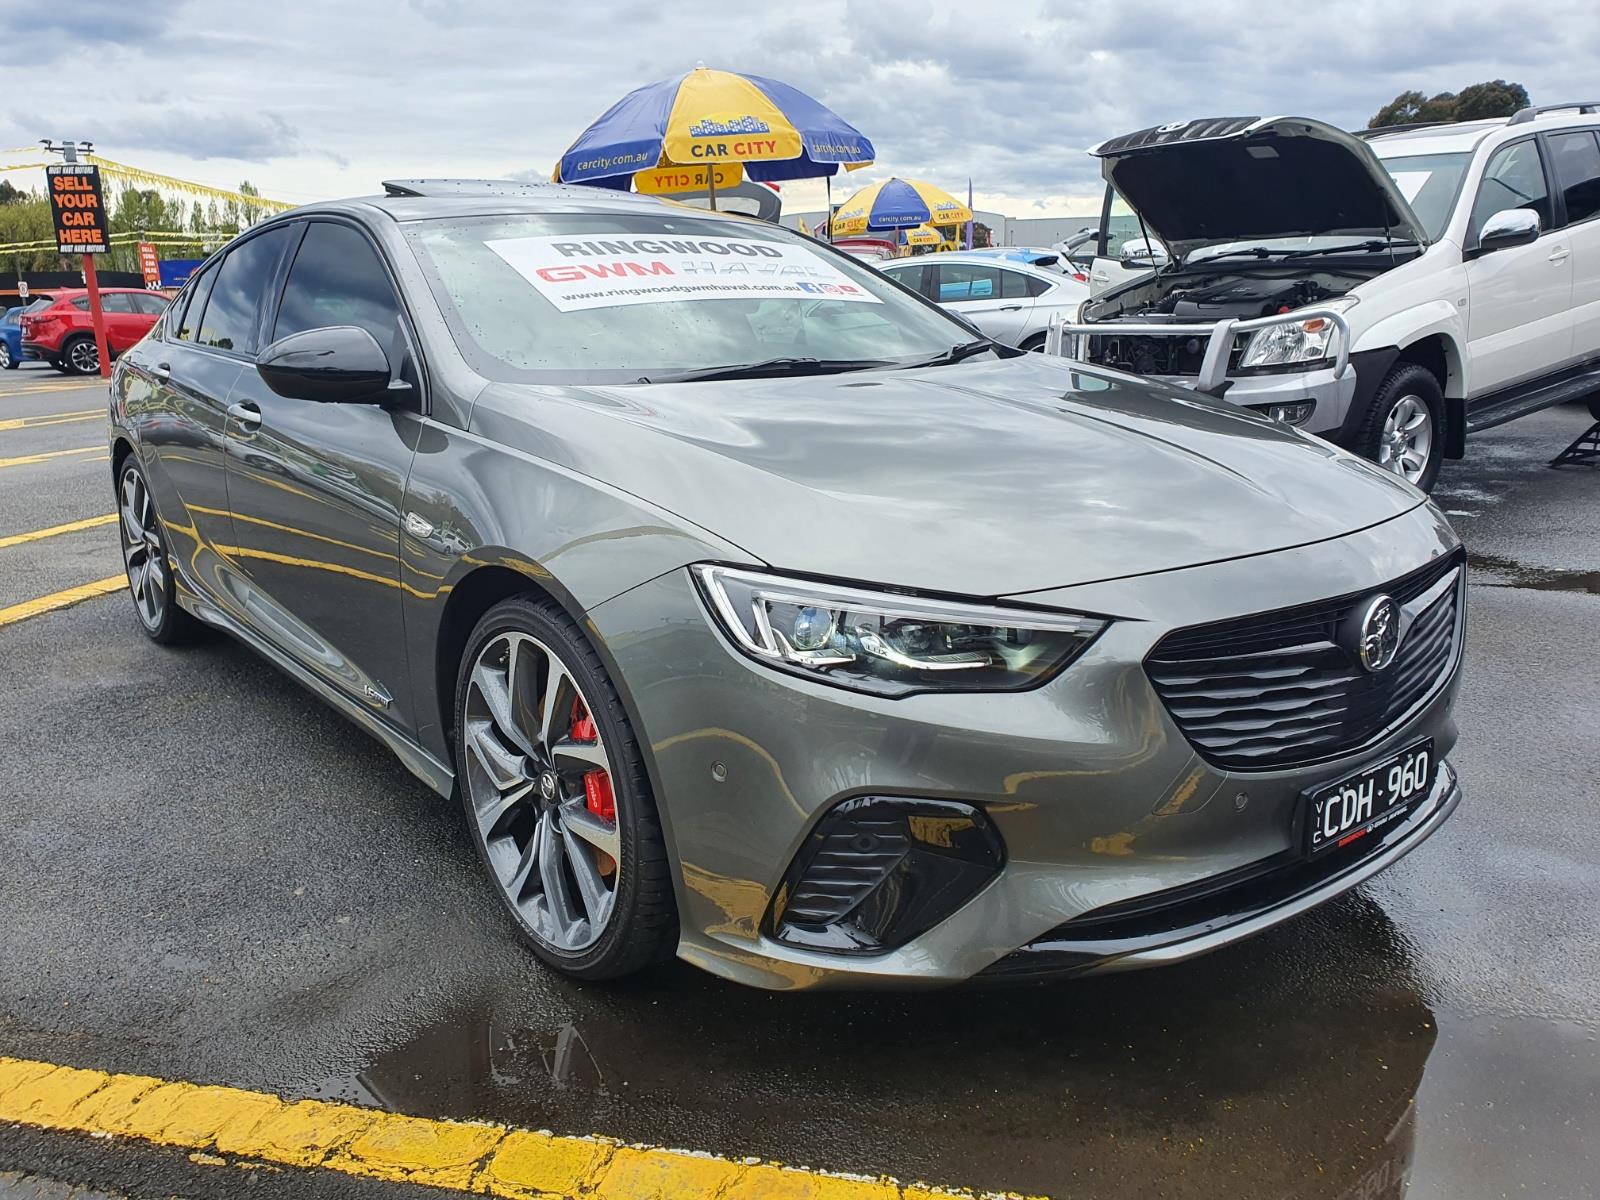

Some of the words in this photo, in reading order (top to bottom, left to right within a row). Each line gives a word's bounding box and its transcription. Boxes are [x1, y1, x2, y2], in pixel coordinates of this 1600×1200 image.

[691, 143, 728, 158] CAR
[733, 140, 777, 155] CITY
[577, 151, 648, 171] carcity.com.au
[53, 176, 93, 191] SELL
[53, 193, 98, 208] YOUR
[62, 211, 95, 226] CAR
[950, 211, 964, 219] CITY
[834, 222, 846, 231] CAR
[59, 229, 103, 243] HERE
[551, 240, 783, 258] RINGWOOD
[535, 261, 676, 283] GWM
[562, 283, 801, 301] www.ringwoodgwmhaval.com.au
[1323, 778, 1374, 838] CDH
[1388, 751, 1429, 806] 960
